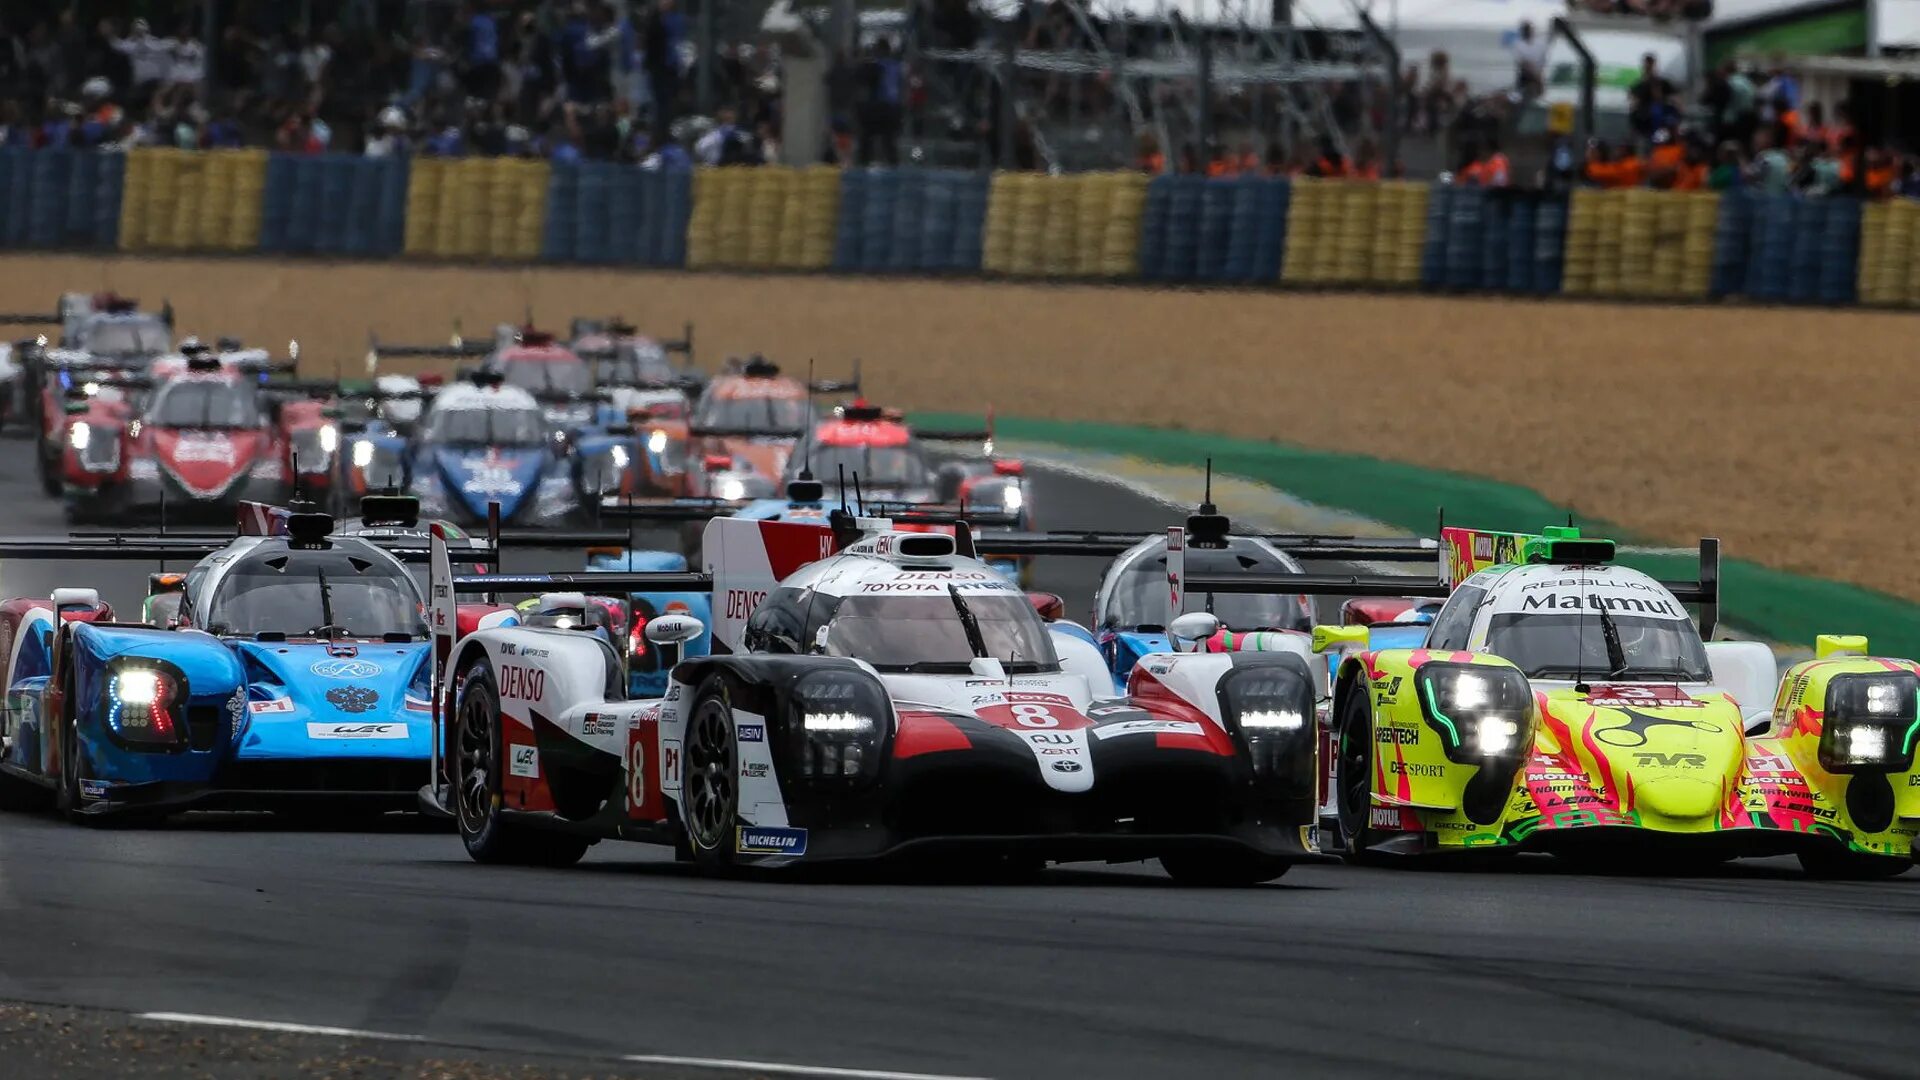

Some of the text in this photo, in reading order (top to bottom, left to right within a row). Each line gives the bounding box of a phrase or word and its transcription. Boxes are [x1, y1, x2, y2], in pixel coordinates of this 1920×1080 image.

[894, 572, 987, 581] DENSO
[862, 583, 940, 592] TOYOTA
[1521, 578, 1665, 596] REBELLION
[1522, 593, 1679, 617] Matmut
[656, 622, 674, 633] Mobil
[500, 665, 544, 701] DENSO
[1007, 693, 1072, 704] TOTAL
[1612, 687, 1656, 698] 3
[253, 701, 286, 712] P1
[1592, 698, 1702, 707] MOTUL
[1011, 704, 1059, 728] 8
[333, 725, 393, 733] WEC
[584, 721, 596, 734] GR
[739, 727, 761, 739] AISIN
[517, 749, 534, 765] WEC
[1040, 747, 1080, 755] ZENT
[665, 748, 678, 781] P1
[1632, 752, 1707, 766] TVR
[1749, 757, 1785, 770] P1
[632, 740, 644, 807] 8
[1409, 764, 1445, 777] SPORT
[1528, 773, 1591, 782] MOTUL
[1744, 777, 1804, 785] MOTUL
[1535, 785, 1607, 795] NORTHWIRE
[1751, 788, 1822, 801] NORTHWIRE
[1372, 808, 1399, 826] MOTUL
[749, 834, 797, 847] MICHELIN
